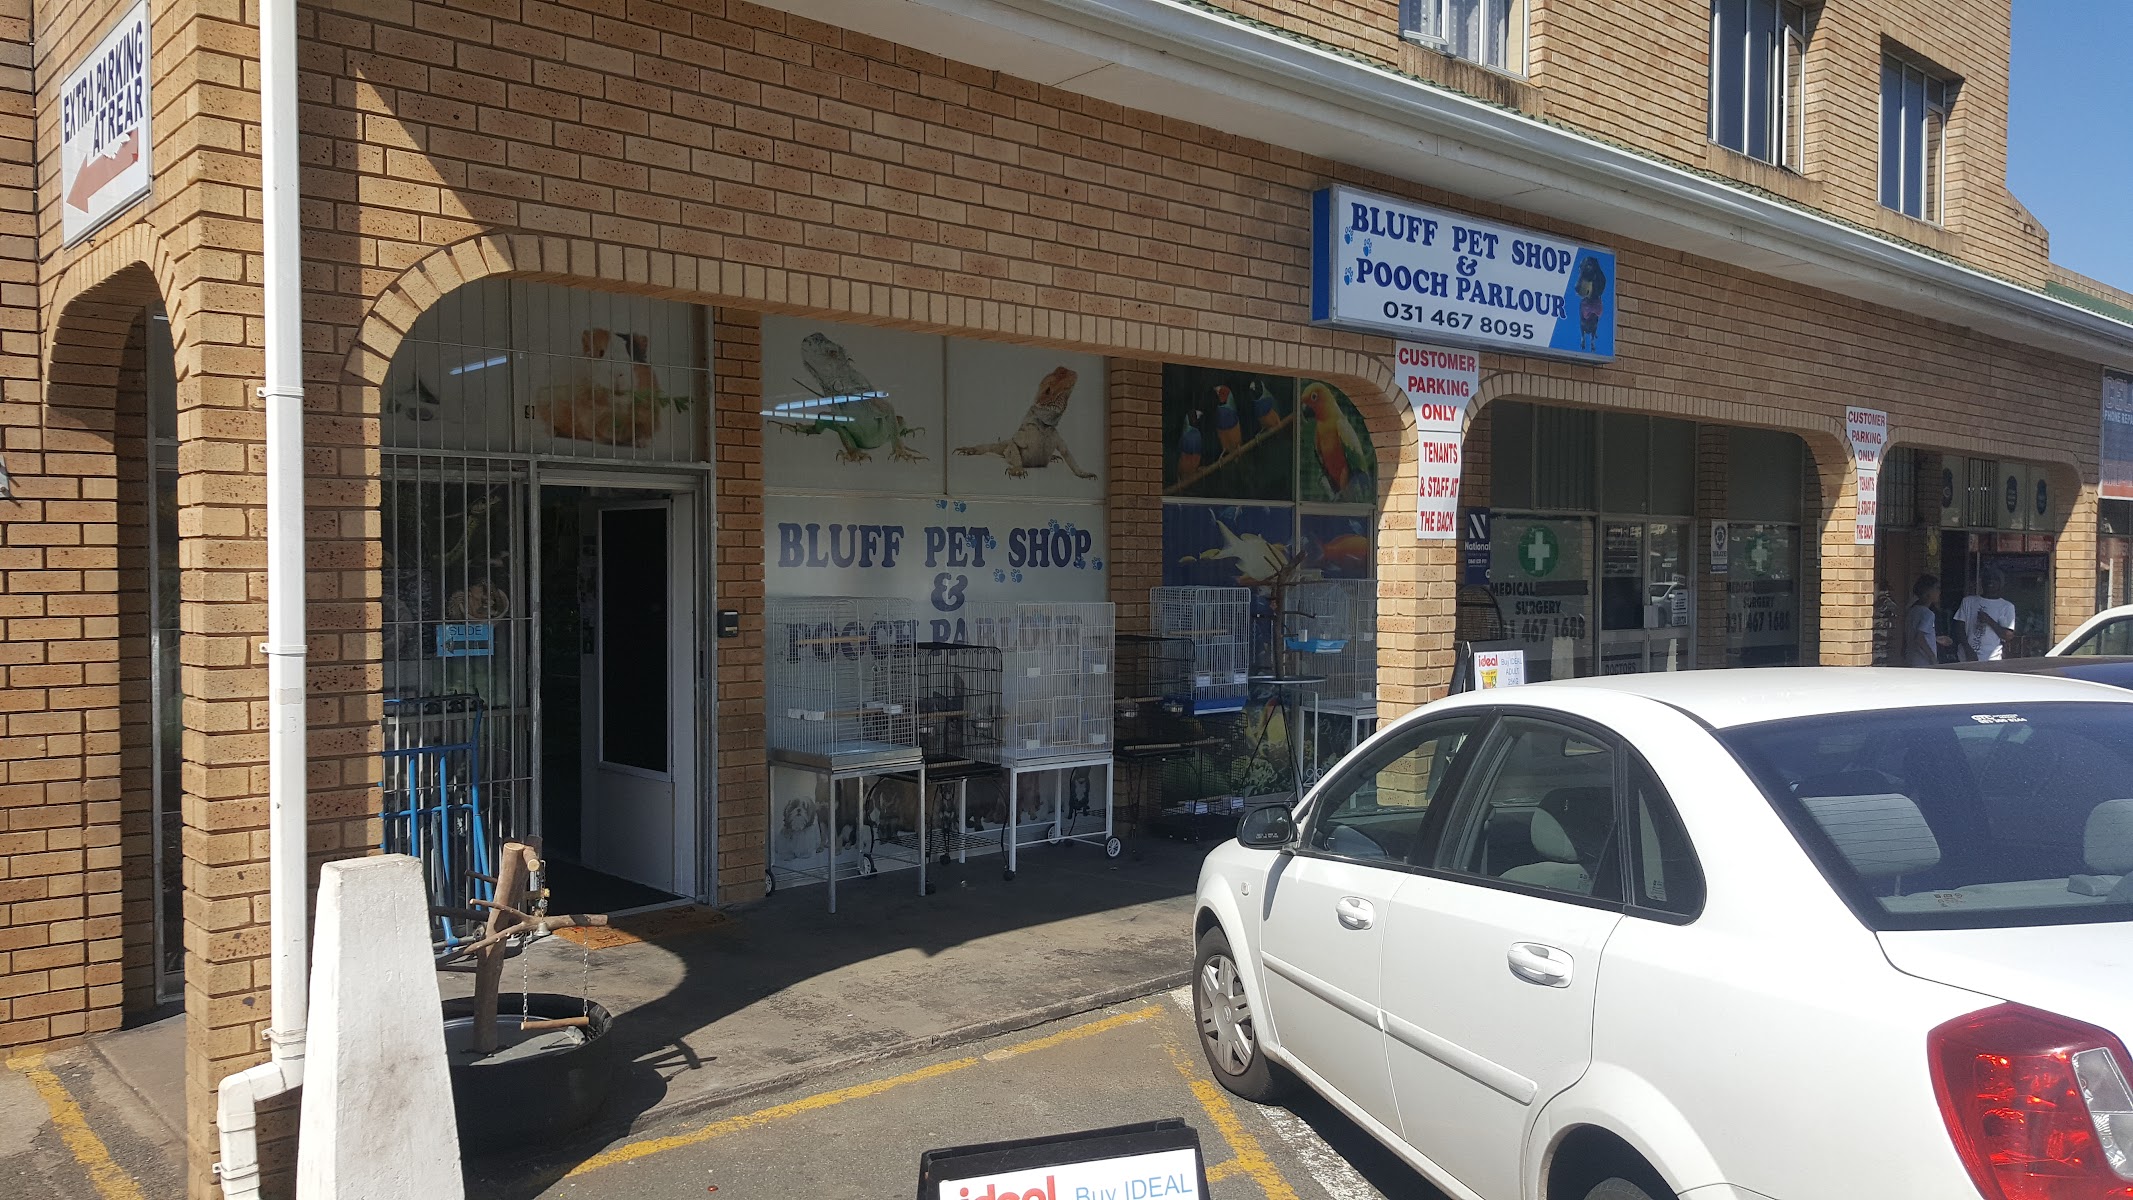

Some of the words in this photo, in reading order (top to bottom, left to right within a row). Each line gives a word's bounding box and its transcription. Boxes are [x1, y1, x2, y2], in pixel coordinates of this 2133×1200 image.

[64, 70, 94, 144] EXTRA
[96, 20, 143, 111] PARKING
[93, 108, 107, 157] AT
[107, 76, 144, 144] REAR
[1351, 202, 1438, 247] BLUFF
[1451, 225, 1499, 260] PET
[1511, 239, 1572, 275] SHOP
[1455, 255, 1478, 277] &
[1356, 257, 1448, 298] POOCH
[1456, 276, 1567, 319] PARLOUR
[1383, 300, 1423, 323] 031
[1430, 308, 1473, 331] 467
[1480, 316, 1534, 340] 8095
[1398, 347, 1476, 373] CUSTOMER
[1408, 375, 1469, 397] PARKING
[2102, 377, 2133, 412] CEL
[1421, 403, 1457, 422] ONLY
[1848, 410, 1886, 427] CUSTOMER
[2104, 409, 2121, 423] PHONE
[1851, 429, 1882, 444] PARKING
[1423, 441, 1458, 464] TENANTS
[1858, 449, 1875, 462] ONLY
[1419, 477, 1426, 497] &
[1427, 476, 1449, 497] STAFF
[1449, 477, 1459, 498] AT
[1859, 475, 1875, 492] TENANTS
[1861, 500, 1871, 515] STAFF
[1871, 500, 1876, 515] AT
[1420, 510, 1435, 532] THE
[1436, 511, 1454, 532] BACK
[1864, 524, 1873, 540] BACK
[778, 522, 905, 568] BLUFF
[924, 526, 991, 568] PET
[1008, 526, 1092, 569] SHOP
[1464, 541, 1490, 551] National
[930, 572, 968, 612] &
[1489, 581, 1536, 597] MEDICAL
[1515, 600, 1562, 615] SURGERY
[1743, 596, 1775, 608] SURGERY
[786, 619, 919, 664] POOCH
[930, 614, 1083, 656] PARLR
[1522, 618, 1548, 643] 467
[1553, 616, 1586, 640] 1688
[1478, 654, 1498, 667] ideal
[1605, 662, 1636, 675] DOCTORS
[1076, 1187, 1117, 1200] Buy
[1125, 1173, 1193, 1200] IDEAL
